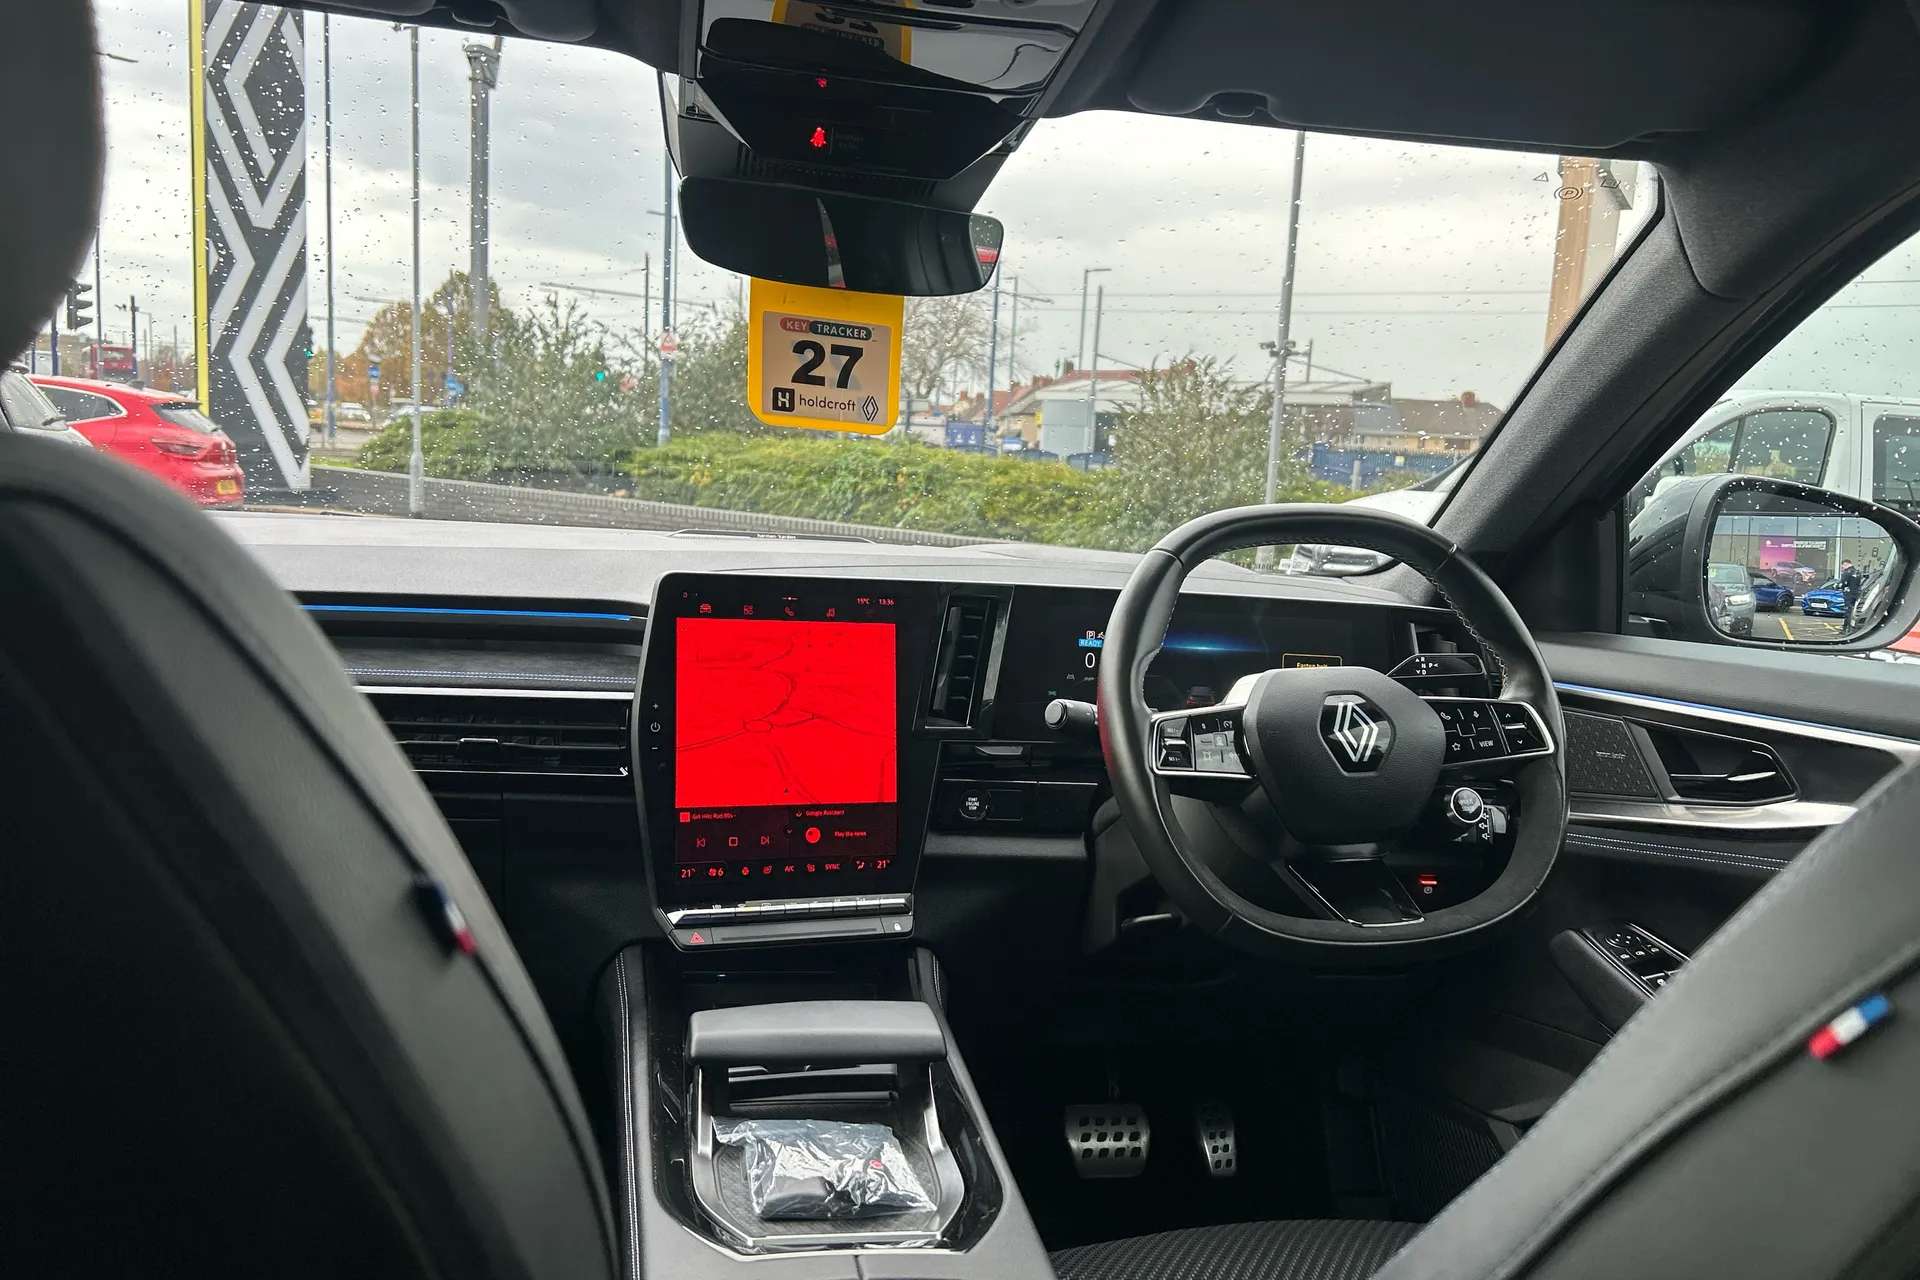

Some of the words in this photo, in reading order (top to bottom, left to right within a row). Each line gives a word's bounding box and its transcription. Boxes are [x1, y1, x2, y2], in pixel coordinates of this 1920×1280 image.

[786, 319, 808, 331] KEY
[815, 323, 867, 339] TRACKER
[791, 340, 863, 389] 27
[799, 394, 857, 412] holdcroft
[1085, 652, 1096, 668] 0
[1479, 739, 1494, 748] VIEW
[717, 867, 724, 877] 6
[784, 865, 795, 873] A/C
[824, 863, 841, 871] SYNC
